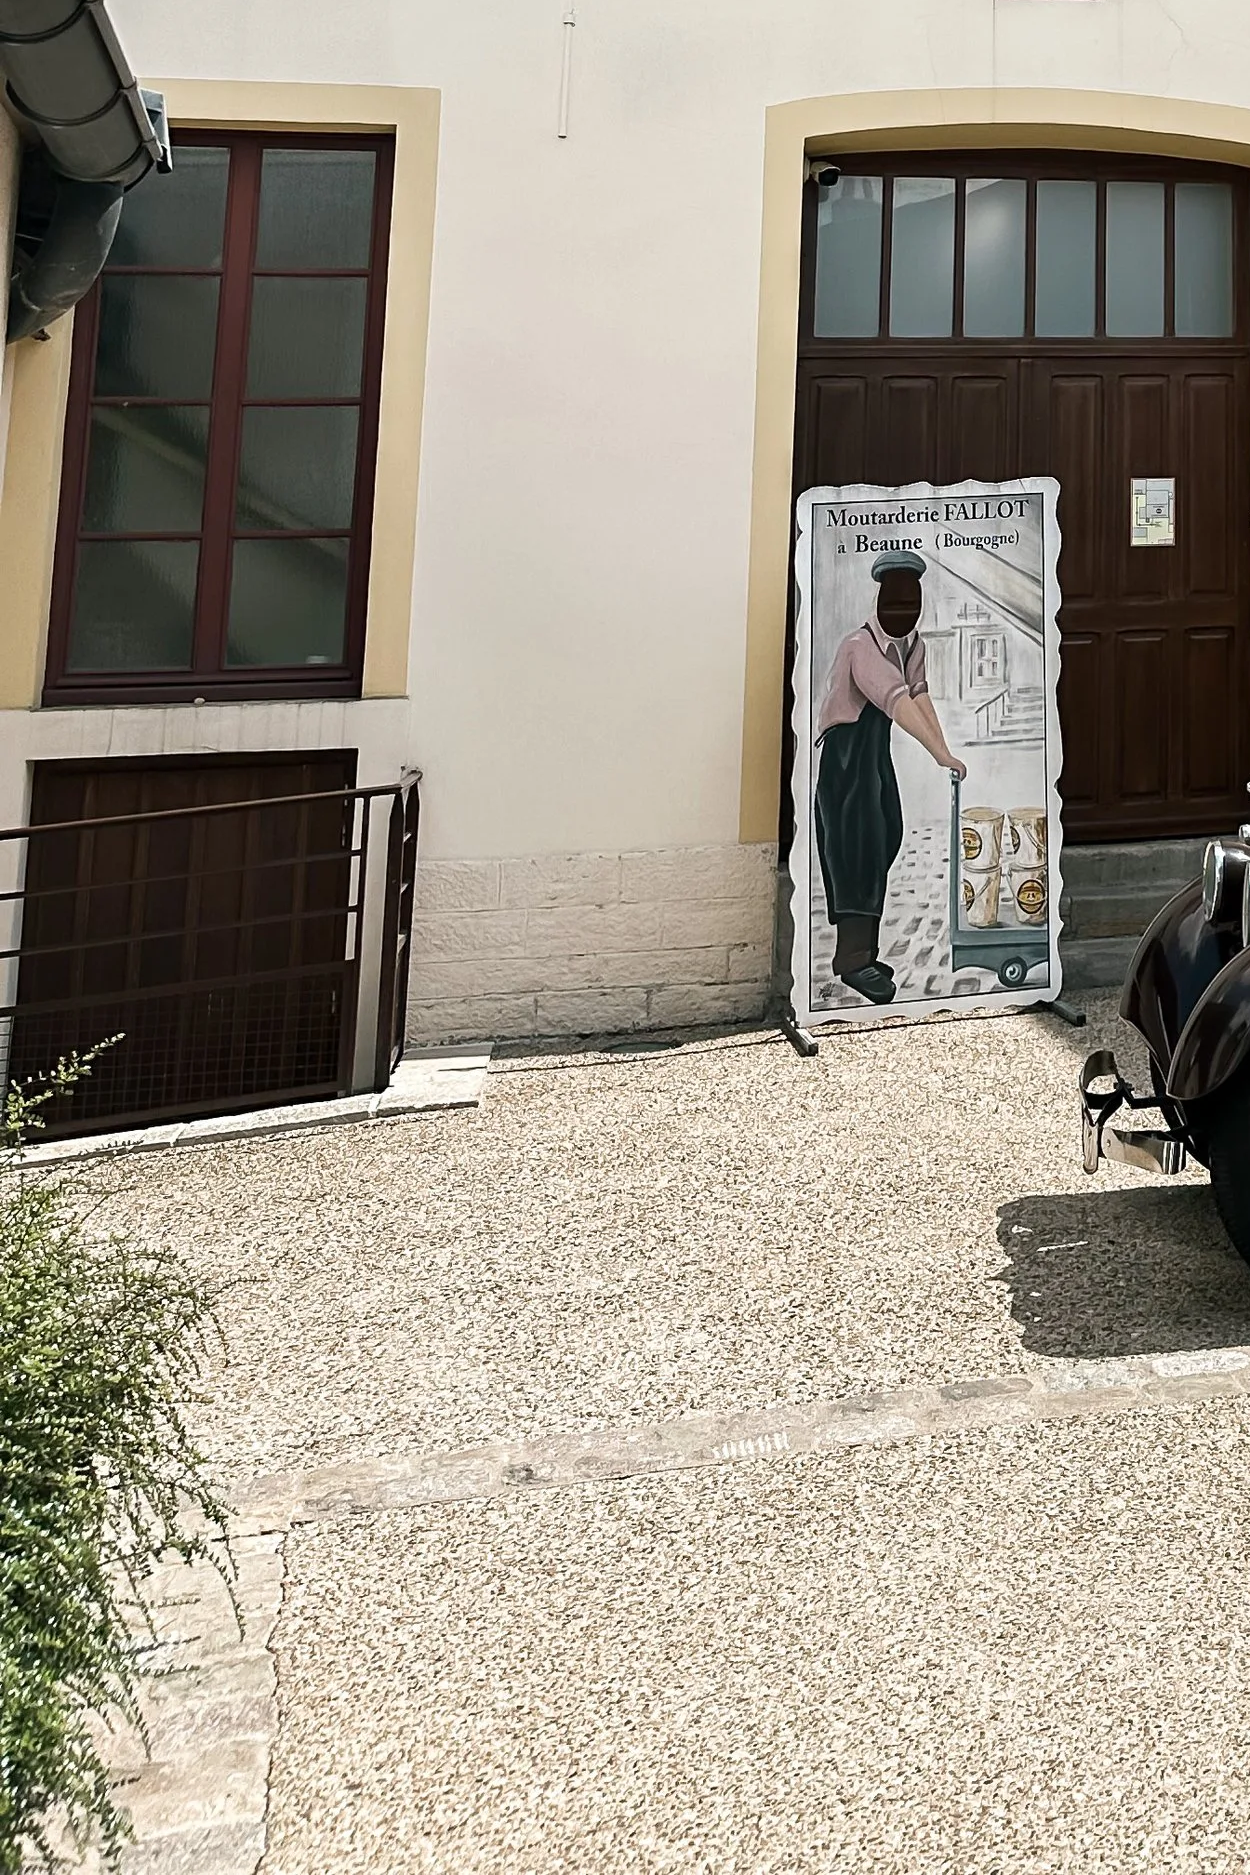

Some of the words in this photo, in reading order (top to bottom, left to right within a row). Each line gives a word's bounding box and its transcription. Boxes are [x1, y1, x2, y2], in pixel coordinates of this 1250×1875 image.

[826, 506, 940, 528] Moutarderie
[943, 499, 1030, 523] FALLOT
[837, 539, 846, 554] à
[855, 535, 923, 553] Beaune
